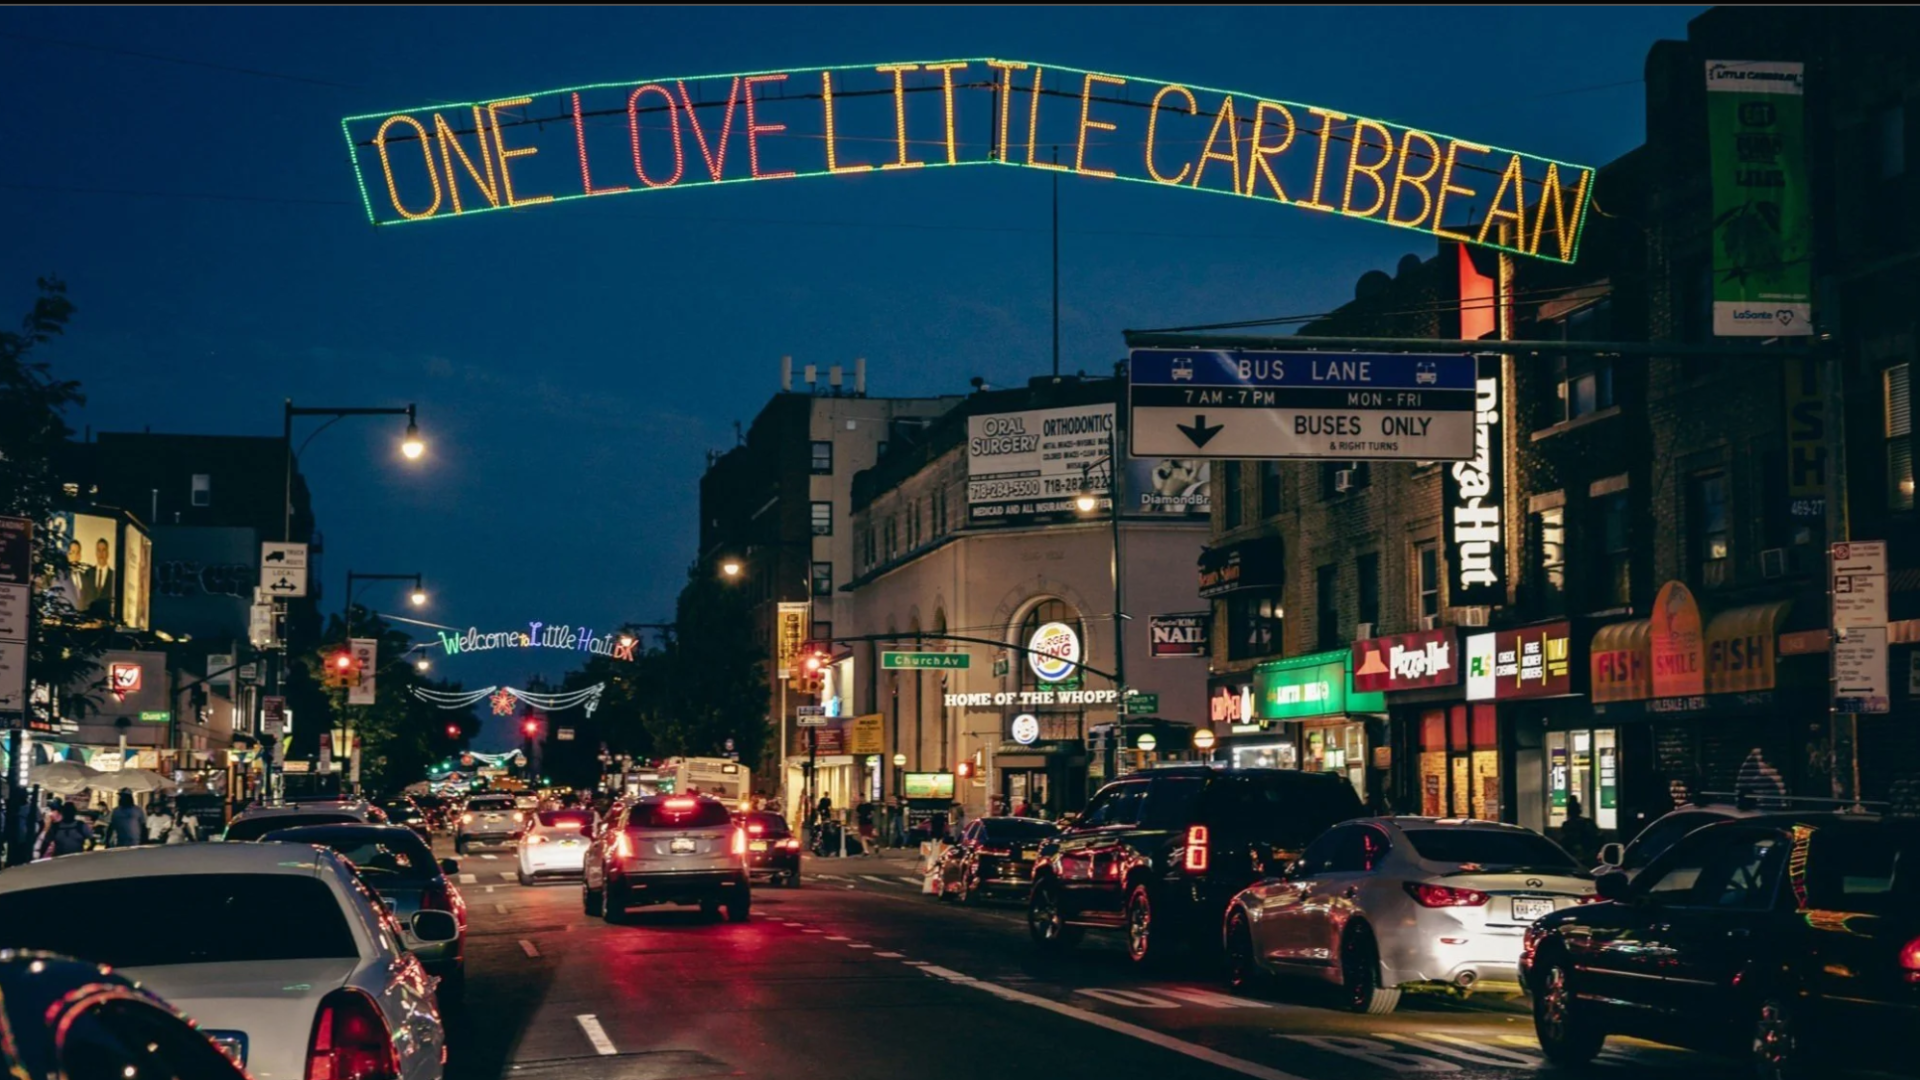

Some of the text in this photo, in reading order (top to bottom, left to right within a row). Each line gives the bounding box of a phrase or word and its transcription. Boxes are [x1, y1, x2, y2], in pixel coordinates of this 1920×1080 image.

[1717, 70, 1745, 79] LITTLE
[372, 60, 1589, 262] ONE LOVE LITTLE CARIBBEAN
[1733, 309, 1773, 319] LaSante
[1238, 359, 1373, 382] BUS LANE
[1252, 391, 1276, 406] PM
[1396, 393, 1422, 408] FRI
[983, 417, 1026, 437] ORAL
[1043, 413, 1113, 437] ORTHODONTICS
[1293, 415, 1433, 437] BUSES ONLY
[970, 433, 1041, 457] SURGERY
[1330, 441, 1399, 451] & RIGHT TURNS
[970, 480, 1041, 500] 718-284-5500
[972, 505, 1004, 517] MEDICAID
[1005, 503, 1020, 515] AND
[1021, 502, 1035, 514] ALL
[1453, 506, 1500, 590] Hut
[437, 626, 520, 655] Welcome
[518, 632, 530, 647] to
[529, 620, 576, 650] Little
[577, 626, 614, 657] Haiti
[1035, 633, 1071, 650] BURGER
[1524, 641, 1540, 654] FREE
[894, 656, 960, 667] Church Av
[1036, 643, 1072, 666] KING
[1389, 641, 1451, 680] Pizza Hut
[1656, 652, 1698, 677] SMILE
[1711, 635, 1764, 673] FISH
[1599, 650, 1641, 683] FISH
[944, 689, 1139, 707] HOME OF THE WHOPP
